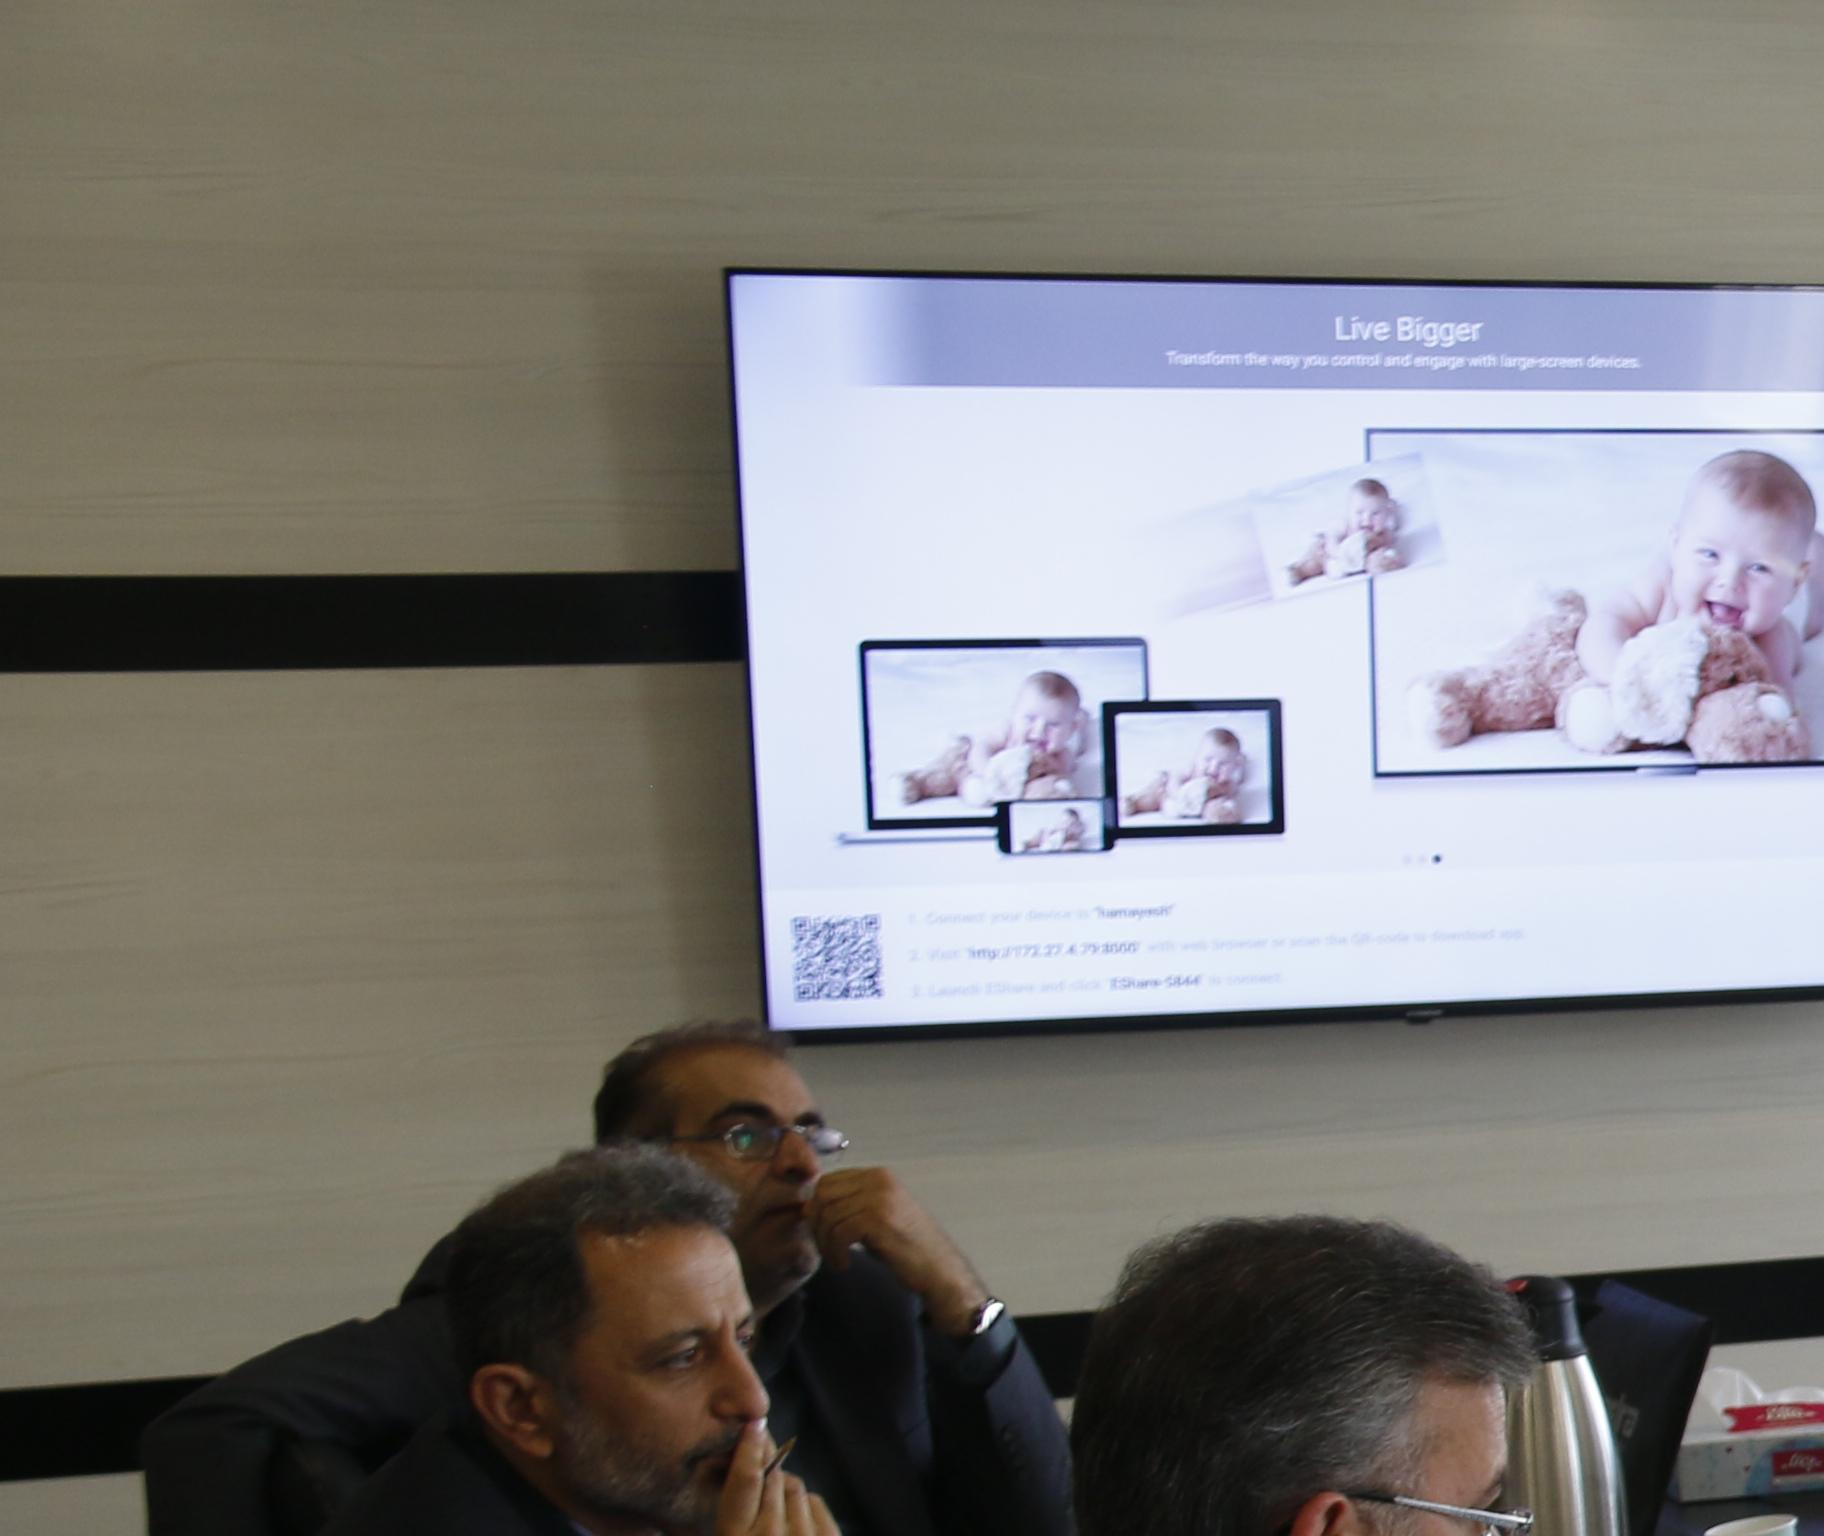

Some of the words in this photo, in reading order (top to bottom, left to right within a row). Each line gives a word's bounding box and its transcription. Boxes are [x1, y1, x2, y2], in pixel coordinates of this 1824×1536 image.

[1335, 316, 1391, 342] Live
[1396, 316, 1483, 347] Bigger
[1165, 349, 1242, 367] Transform
[1244, 350, 1267, 367] the
[1270, 354, 1300, 370] way
[1302, 355, 1327, 370] you
[1331, 351, 1380, 368] control
[1383, 352, 1410, 368] and
[1413, 355, 1464, 371] engage
[1468, 352, 1498, 368] with
[1501, 352, 1583, 371] large-screen
[1289, 935, 1321, 948] scan
[1324, 933, 1348, 947] the
